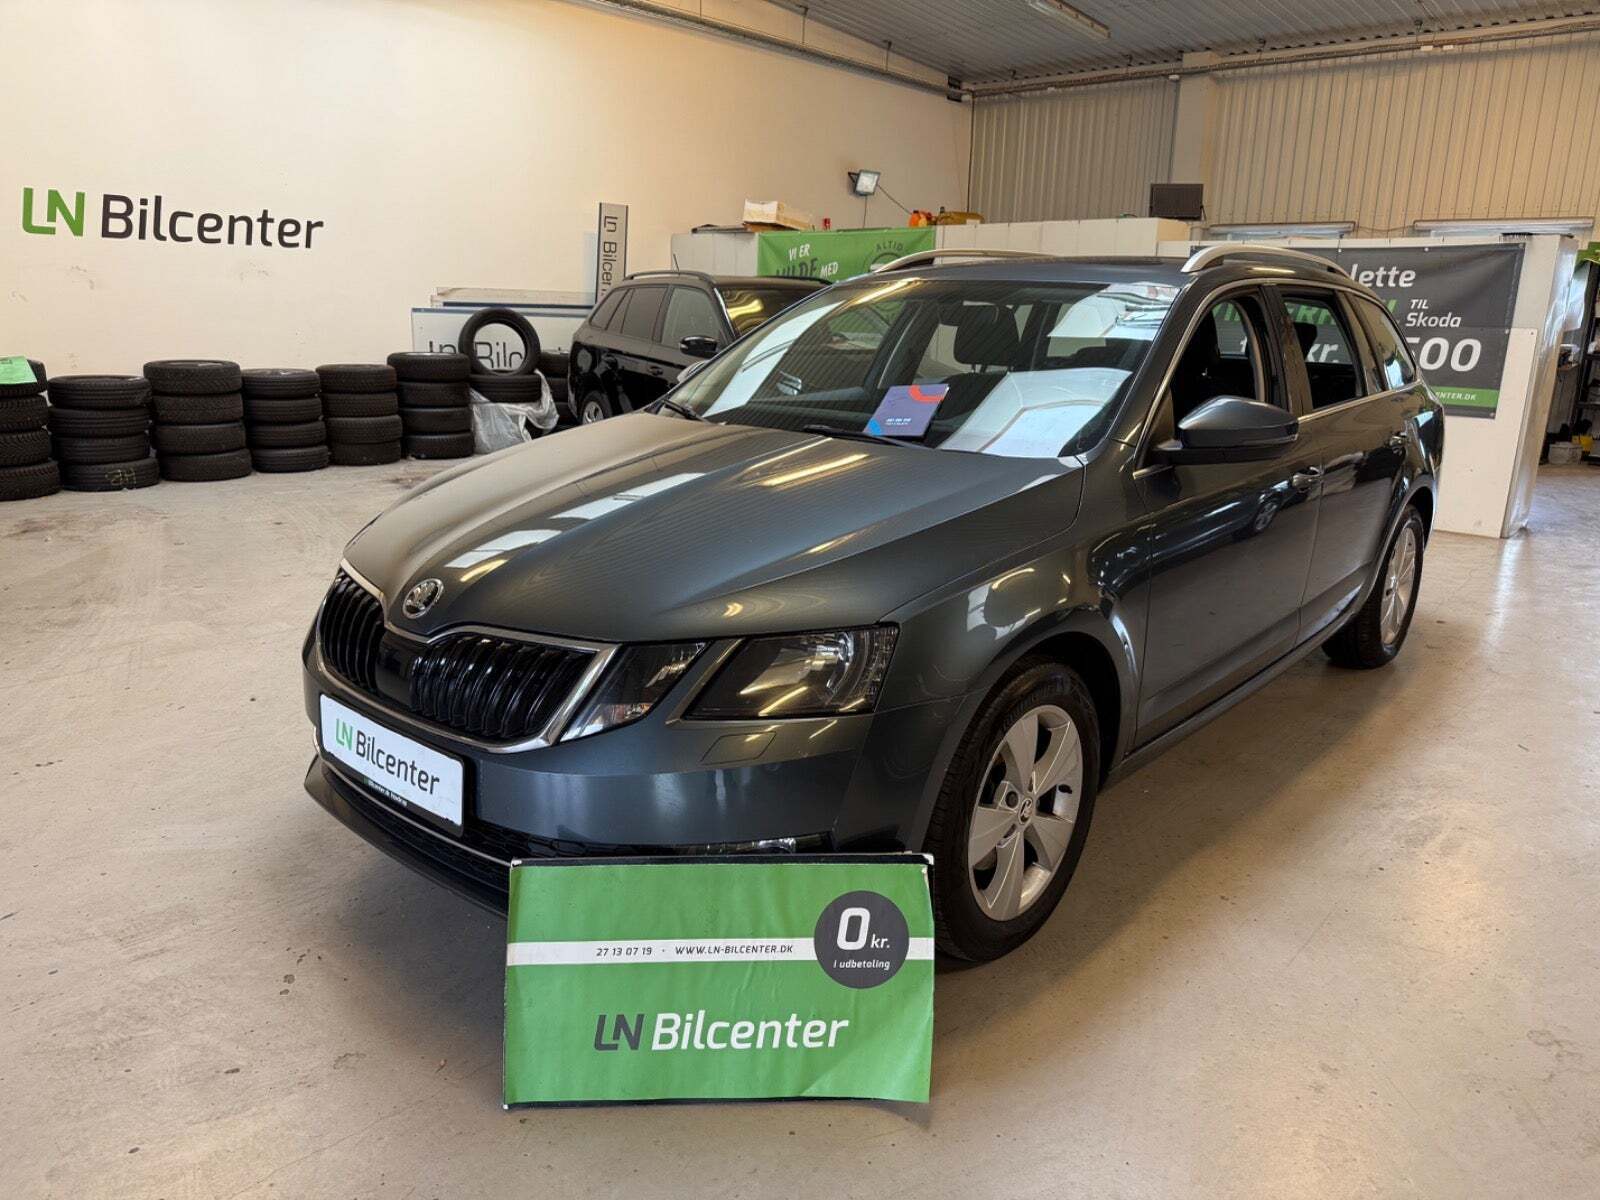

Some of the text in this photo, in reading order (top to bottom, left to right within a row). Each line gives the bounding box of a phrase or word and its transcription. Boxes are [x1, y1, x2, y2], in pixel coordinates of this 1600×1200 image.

[22, 187, 325, 249] LN Bilcenter
[604, 215, 618, 232] Ln
[799, 243, 810, 258] ER
[819, 261, 839, 279] MED
[1410, 299, 1429, 310] TIL
[1405, 311, 1462, 328] Skoda
[335, 718, 353, 751] LN
[355, 729, 440, 795] Bilcenter
[836, 907, 891, 951] 0 kr.
[596, 948, 609, 957] 27
[612, 948, 623, 957] 13
[625, 947, 639, 956] 07
[641, 947, 653, 956] 19
[839, 959, 891, 971] udbetaling
[593, 1009, 850, 1051] LN Bilcenter
